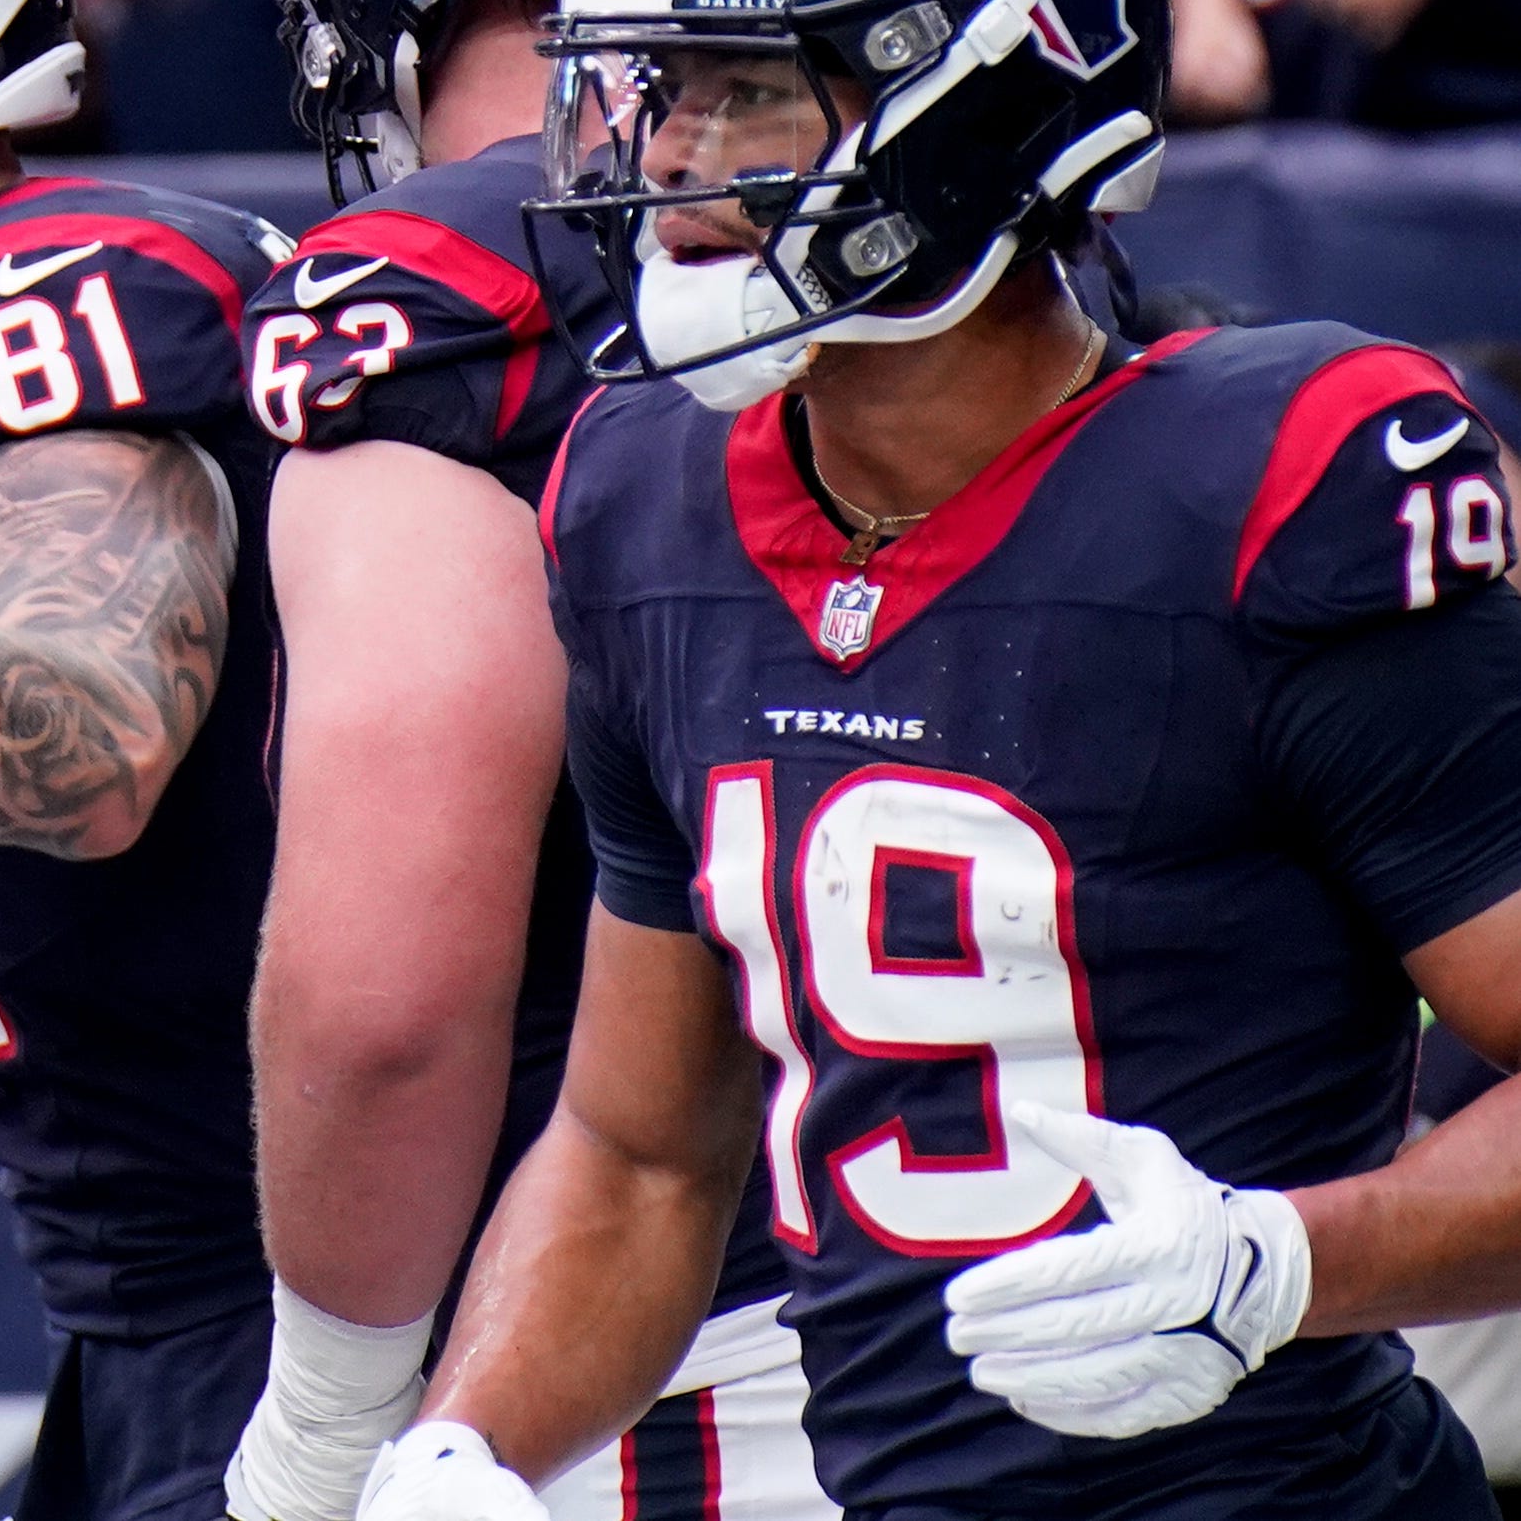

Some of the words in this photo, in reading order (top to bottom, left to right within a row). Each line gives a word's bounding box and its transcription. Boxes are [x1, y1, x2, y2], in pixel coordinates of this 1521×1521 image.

[252, 301, 414, 449] 63
[1395, 473, 1507, 611] 19
[763, 710, 927, 740] TEXANS
[694, 758, 1107, 1258] 19
